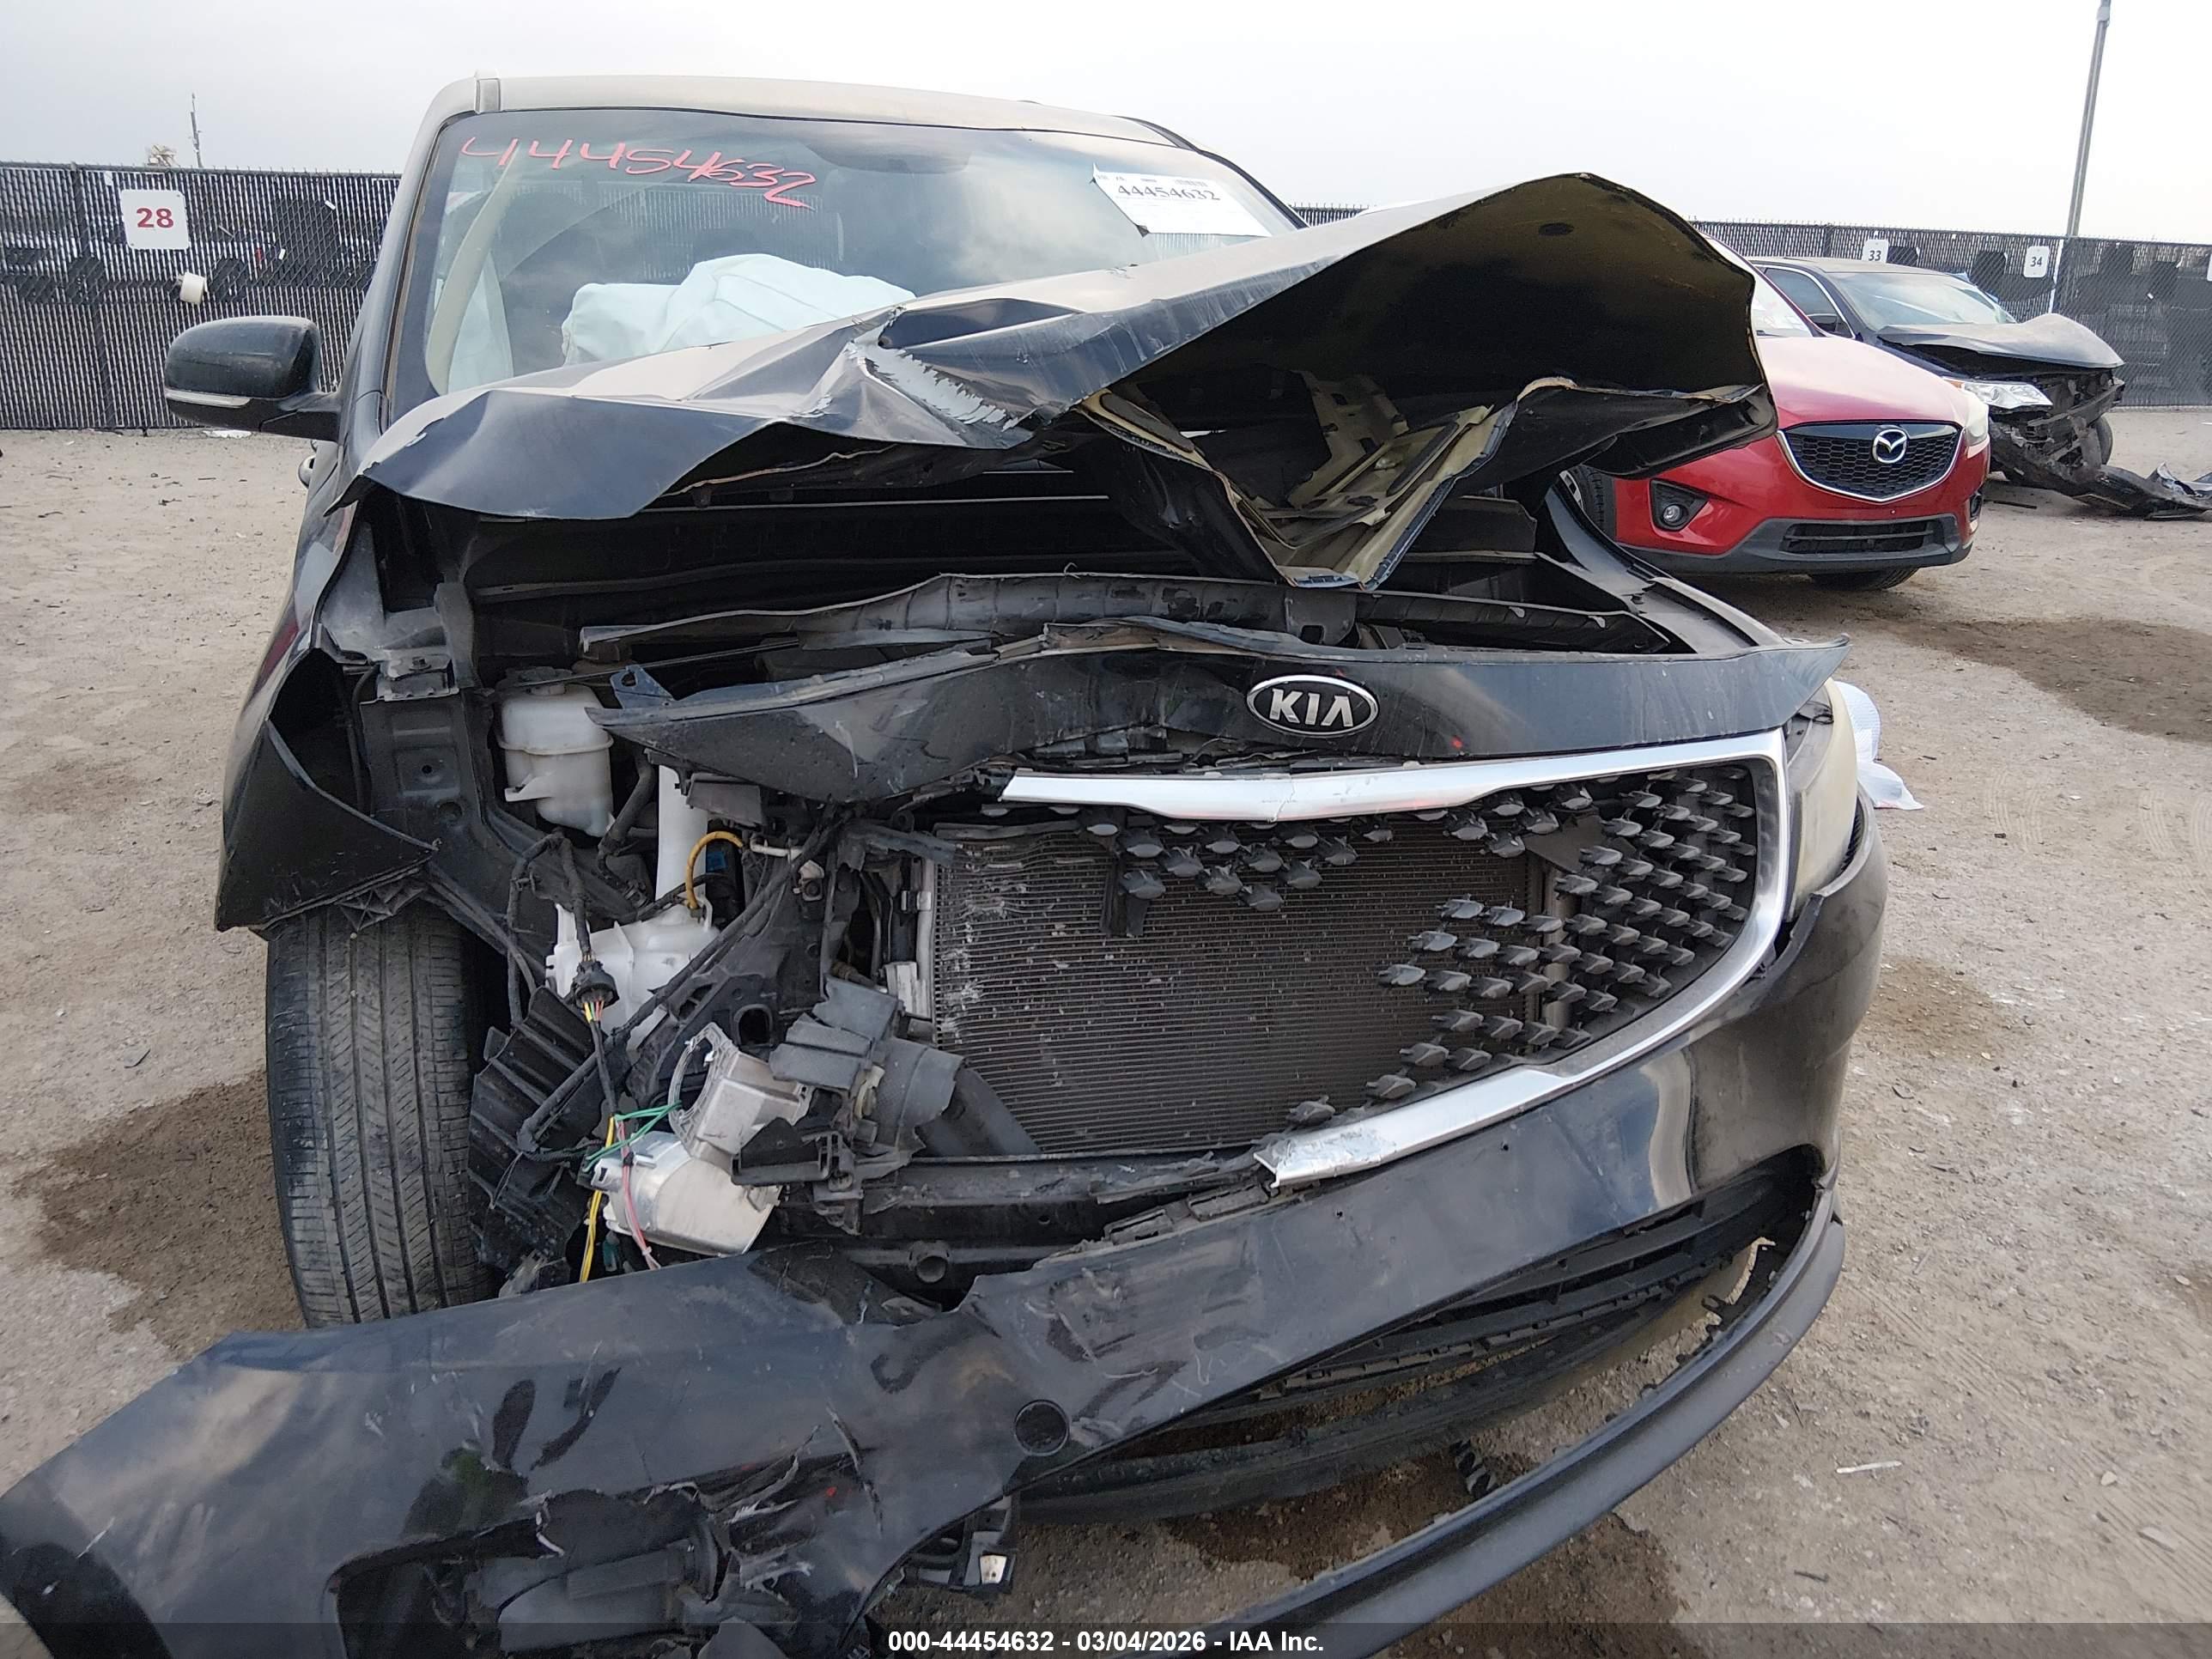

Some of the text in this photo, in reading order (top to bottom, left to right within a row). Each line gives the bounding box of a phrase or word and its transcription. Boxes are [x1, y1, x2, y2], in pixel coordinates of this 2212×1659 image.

[460, 137, 817, 211] 44454632
[1118, 185, 1220, 201] 44454632
[137, 208, 173, 228] 28
[1868, 250, 1881, 262] 33
[2030, 257, 2043, 268] 34
[1269, 688, 1354, 727] KIA
